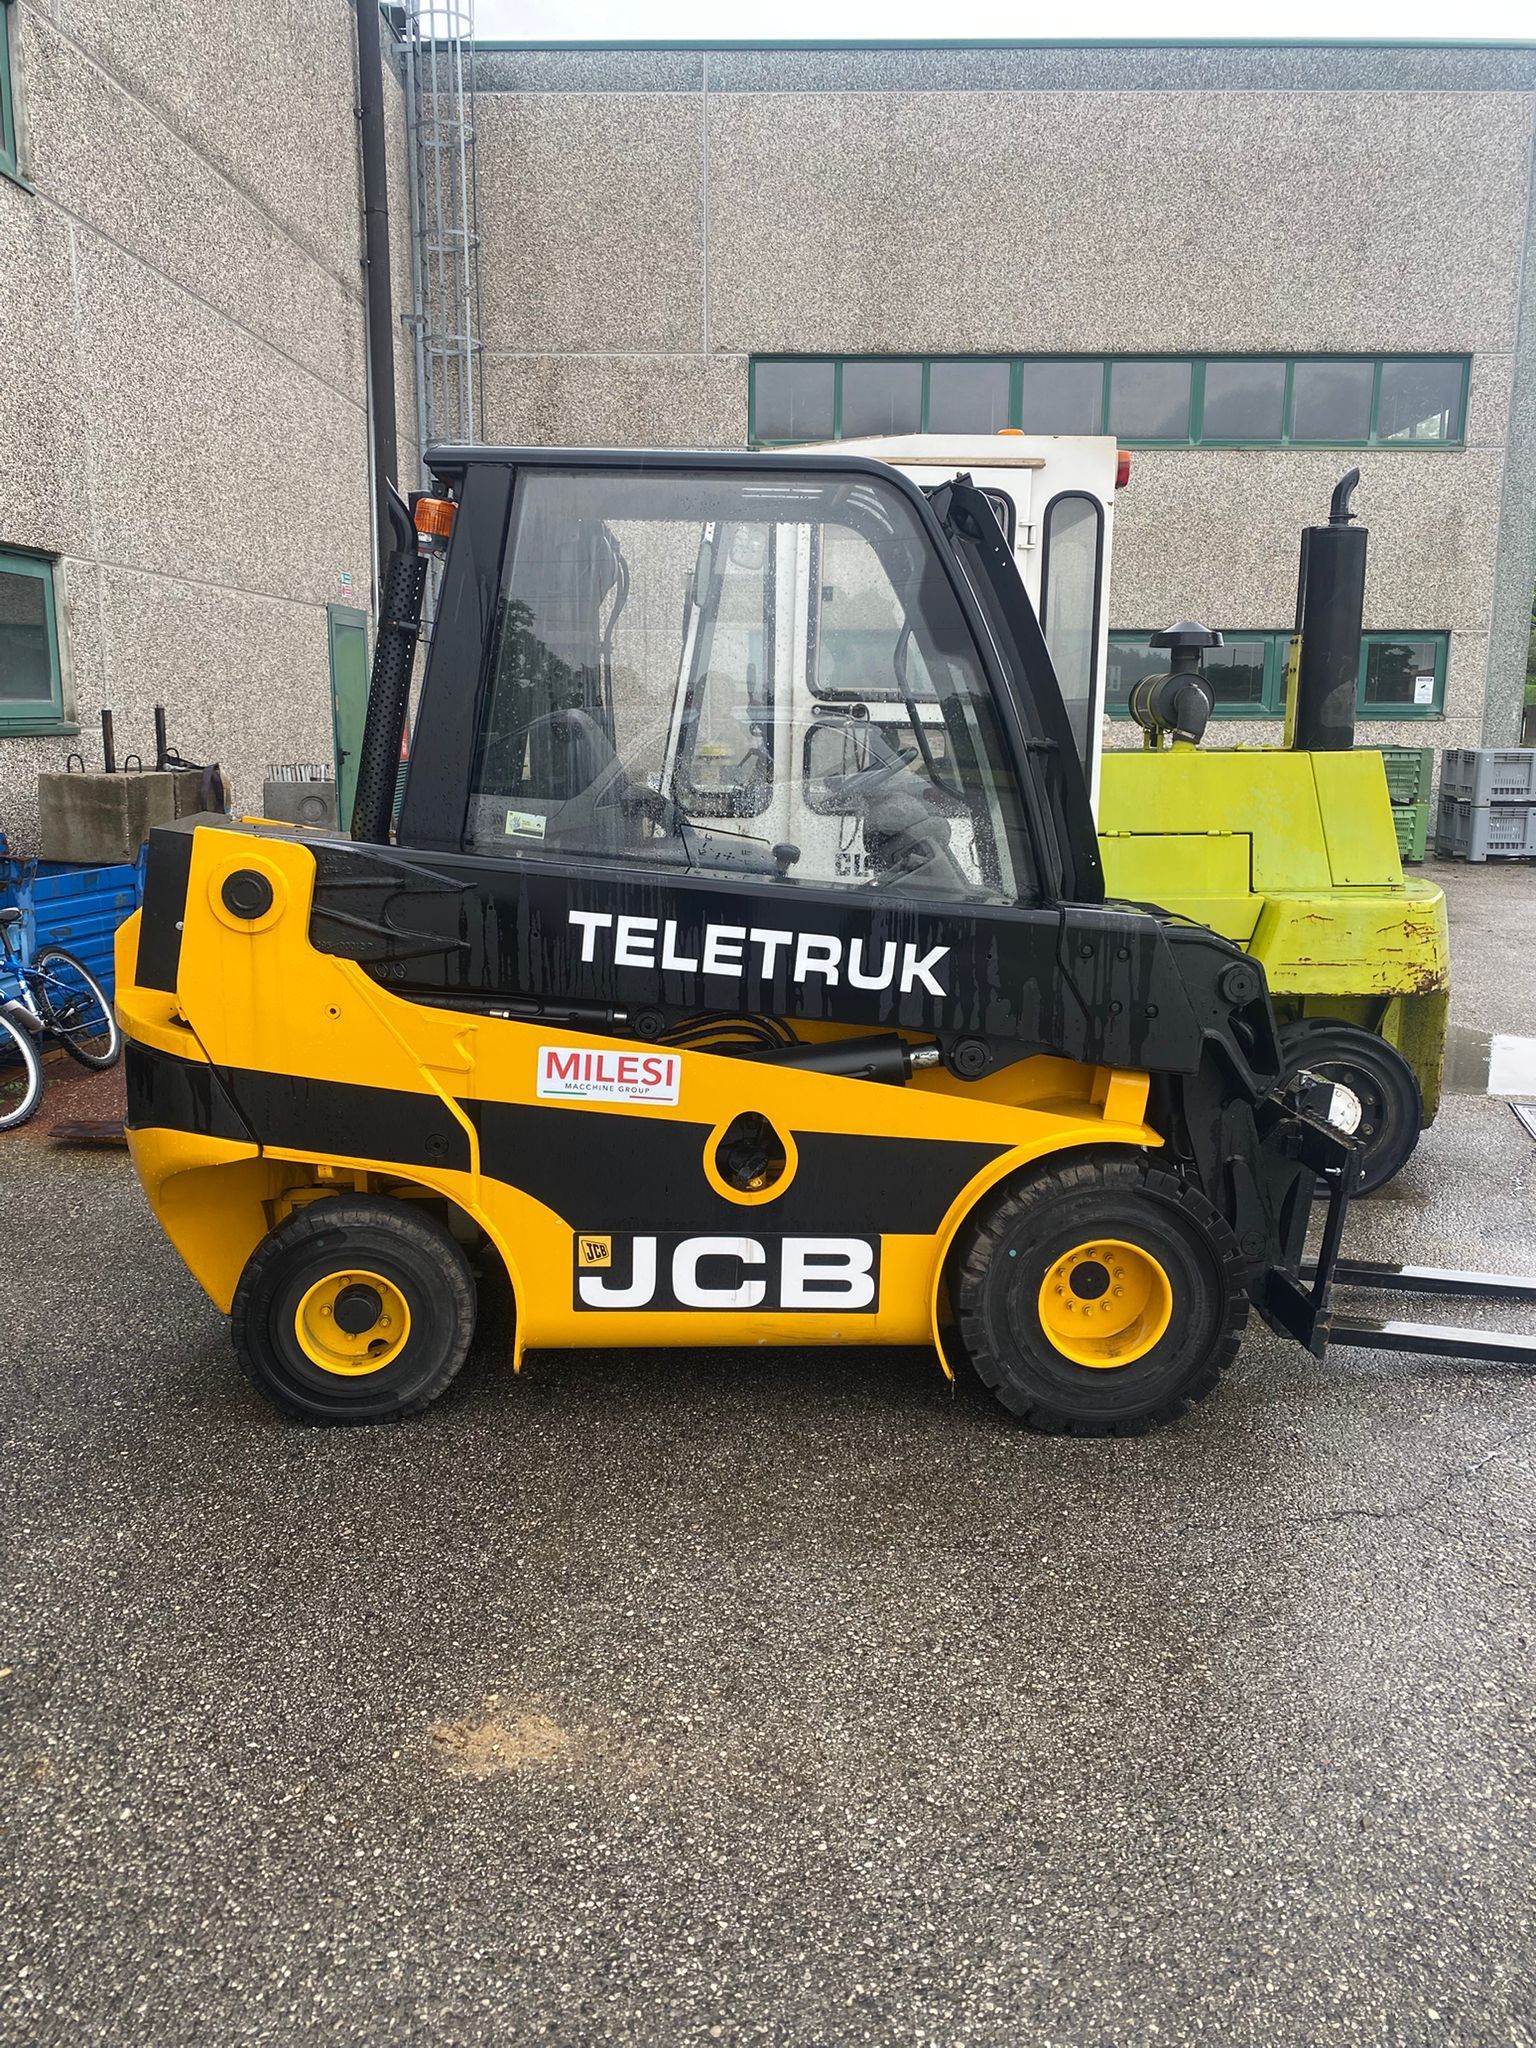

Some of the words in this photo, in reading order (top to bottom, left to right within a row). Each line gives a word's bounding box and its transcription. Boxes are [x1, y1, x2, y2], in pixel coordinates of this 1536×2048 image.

[568, 910, 951, 996] TELETRUK
[546, 1051, 673, 1086] MILESI
[565, 1083, 614, 1092] MACCHINE
[618, 1086, 650, 1094] GROUP
[586, 1242, 607, 1261] JCB
[579, 1236, 875, 1308] JCB
